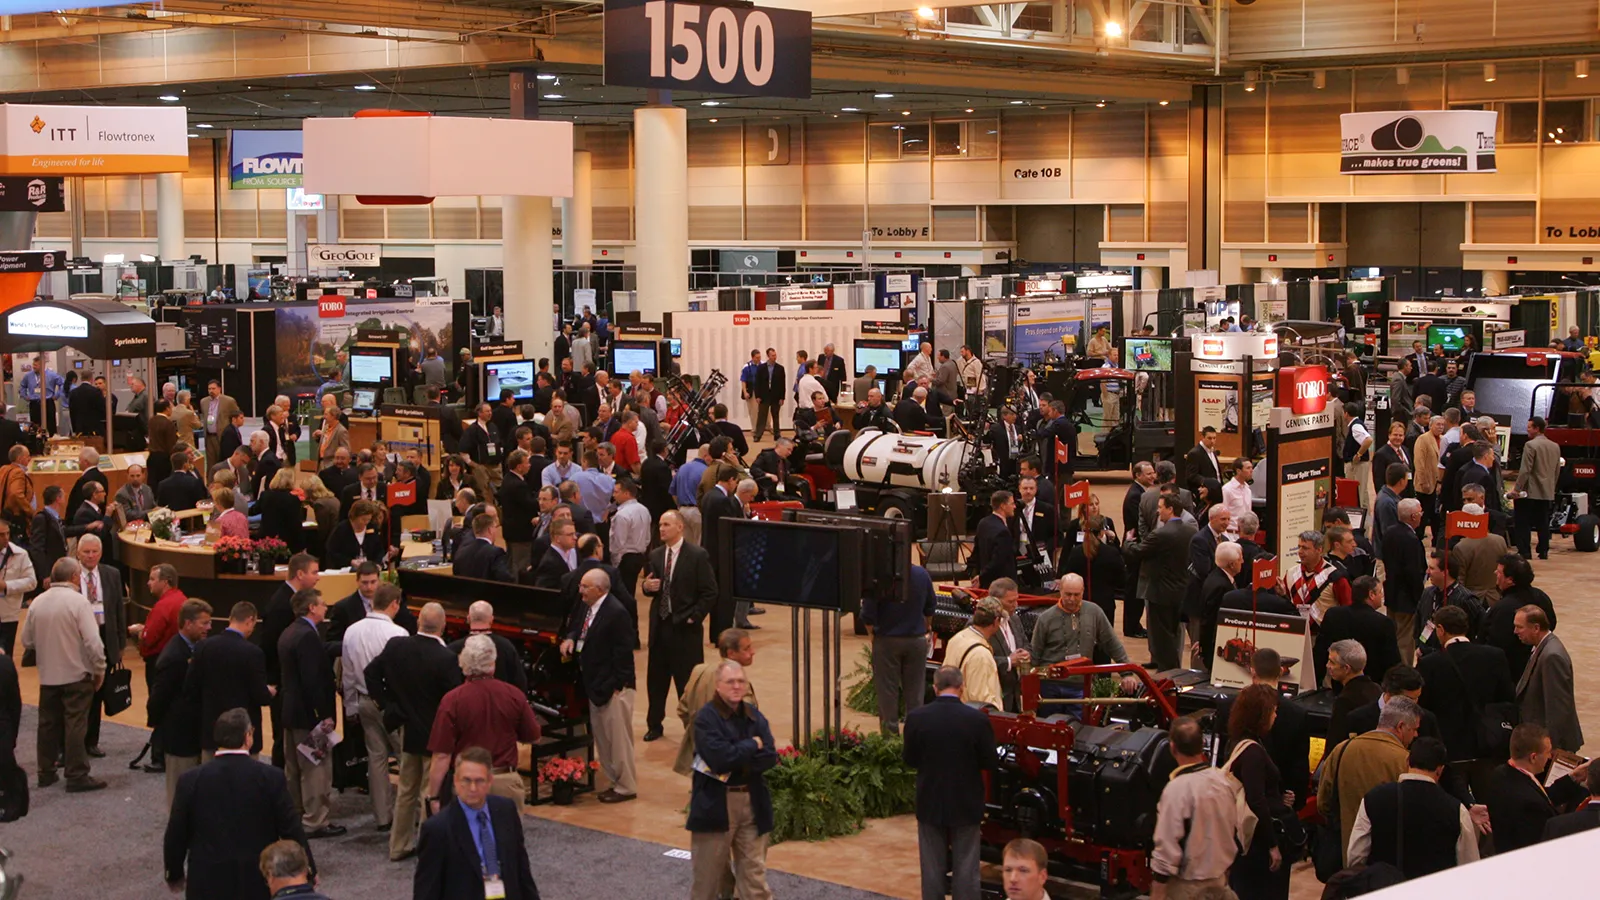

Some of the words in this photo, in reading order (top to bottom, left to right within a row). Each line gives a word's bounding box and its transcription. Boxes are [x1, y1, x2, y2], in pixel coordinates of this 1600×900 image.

[645, 0, 775, 87] 1500
[51, 128, 77, 141] ITT
[98, 131, 155, 142] Flowtronex
[32, 158, 77, 168] Engineered
[79, 158, 91, 167] for
[92, 158, 104, 167] life
[1396, 158, 1418, 168] true
[1420, 156, 1462, 168] greens!
[1014, 169, 1038, 179] Gate
[29, 184, 46, 195] R&R
[872, 228, 883, 236] To
[887, 227, 917, 238] Lobby
[922, 227, 928, 236] E
[1546, 227, 1562, 238] To
[320, 302, 343, 312] TORO
[1036, 328, 1052, 336] depend
[114, 337, 147, 347] Sprinklers
[1296, 380, 1326, 400] TORO
[1286, 418, 1310, 428] GENUINE
[1312, 415, 1330, 424] PARTS
[1070, 491, 1083, 499] NEW
[1260, 569, 1272, 578] NEW
